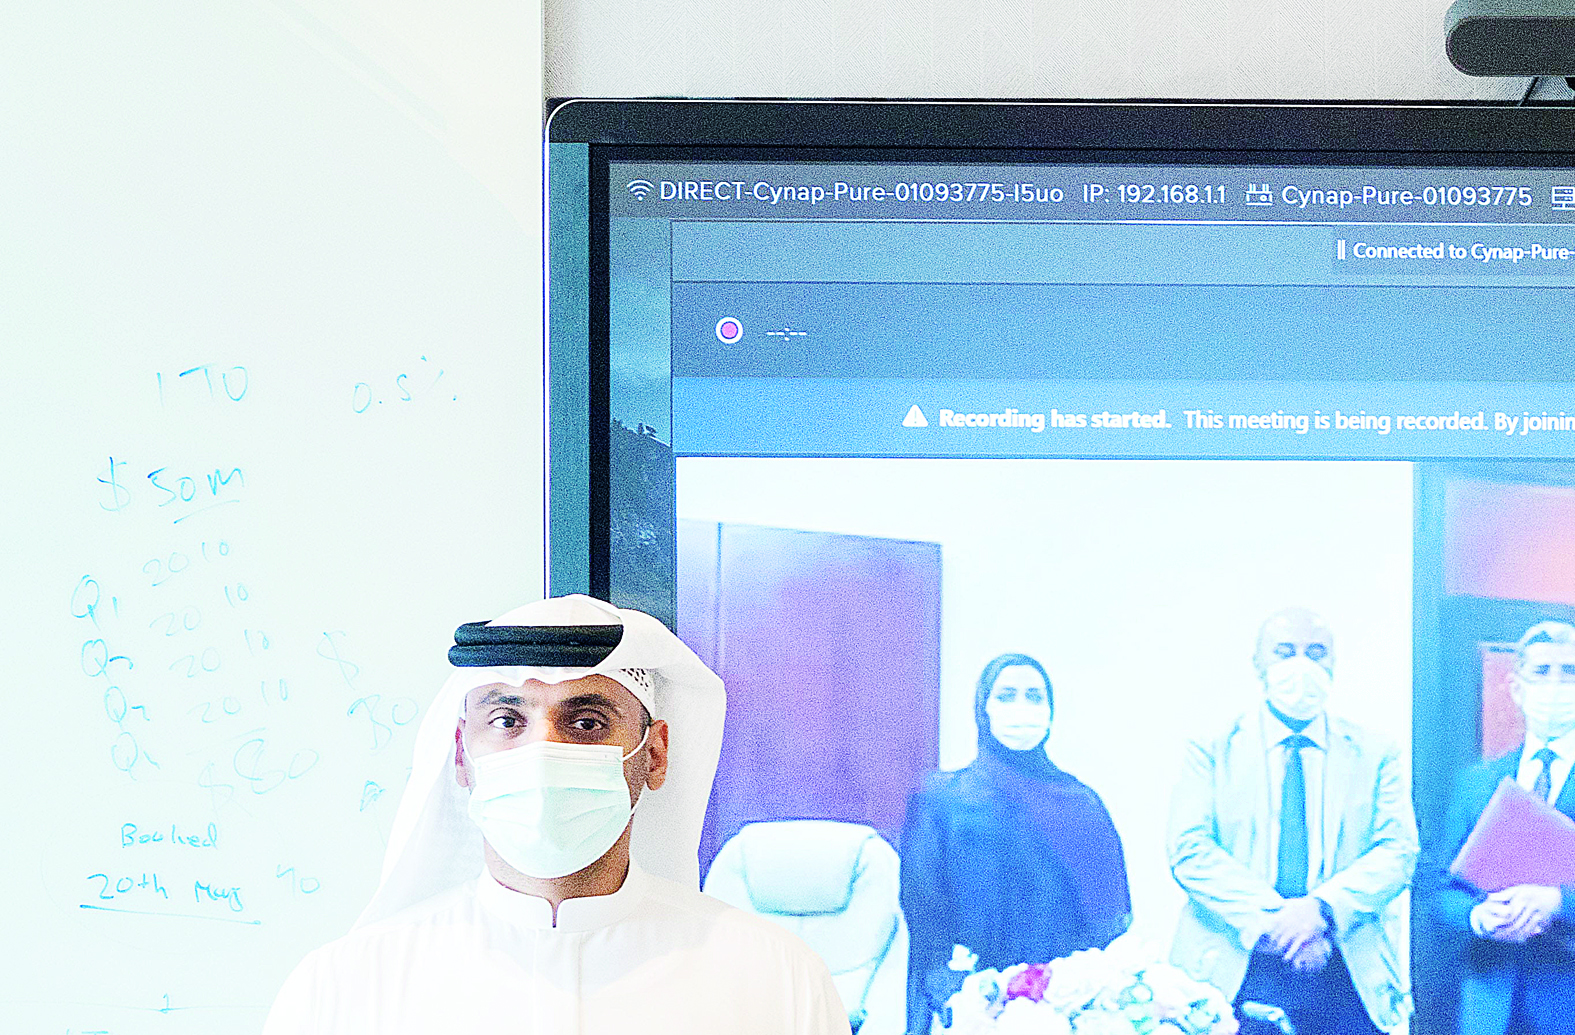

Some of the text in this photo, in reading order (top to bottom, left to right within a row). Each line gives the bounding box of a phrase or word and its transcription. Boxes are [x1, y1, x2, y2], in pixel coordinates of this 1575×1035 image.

[1082, 183, 1227, 205] IP: 192.168.1.1
[1281, 185, 1533, 209] Cynap-Pure-01093775
[1352, 241, 1445, 260] Connected
[1449, 243, 1468, 260] to
[938, 409, 1045, 433] Recording
[1051, 410, 1092, 429] has
[1095, 411, 1173, 430] started.
[1184, 411, 1224, 431] This
[1229, 411, 1309, 434] meeting
[1314, 412, 1331, 431] is
[1335, 412, 1392, 435] being
[1397, 412, 1489, 432] recorded.
[1495, 413, 1520, 436] By
